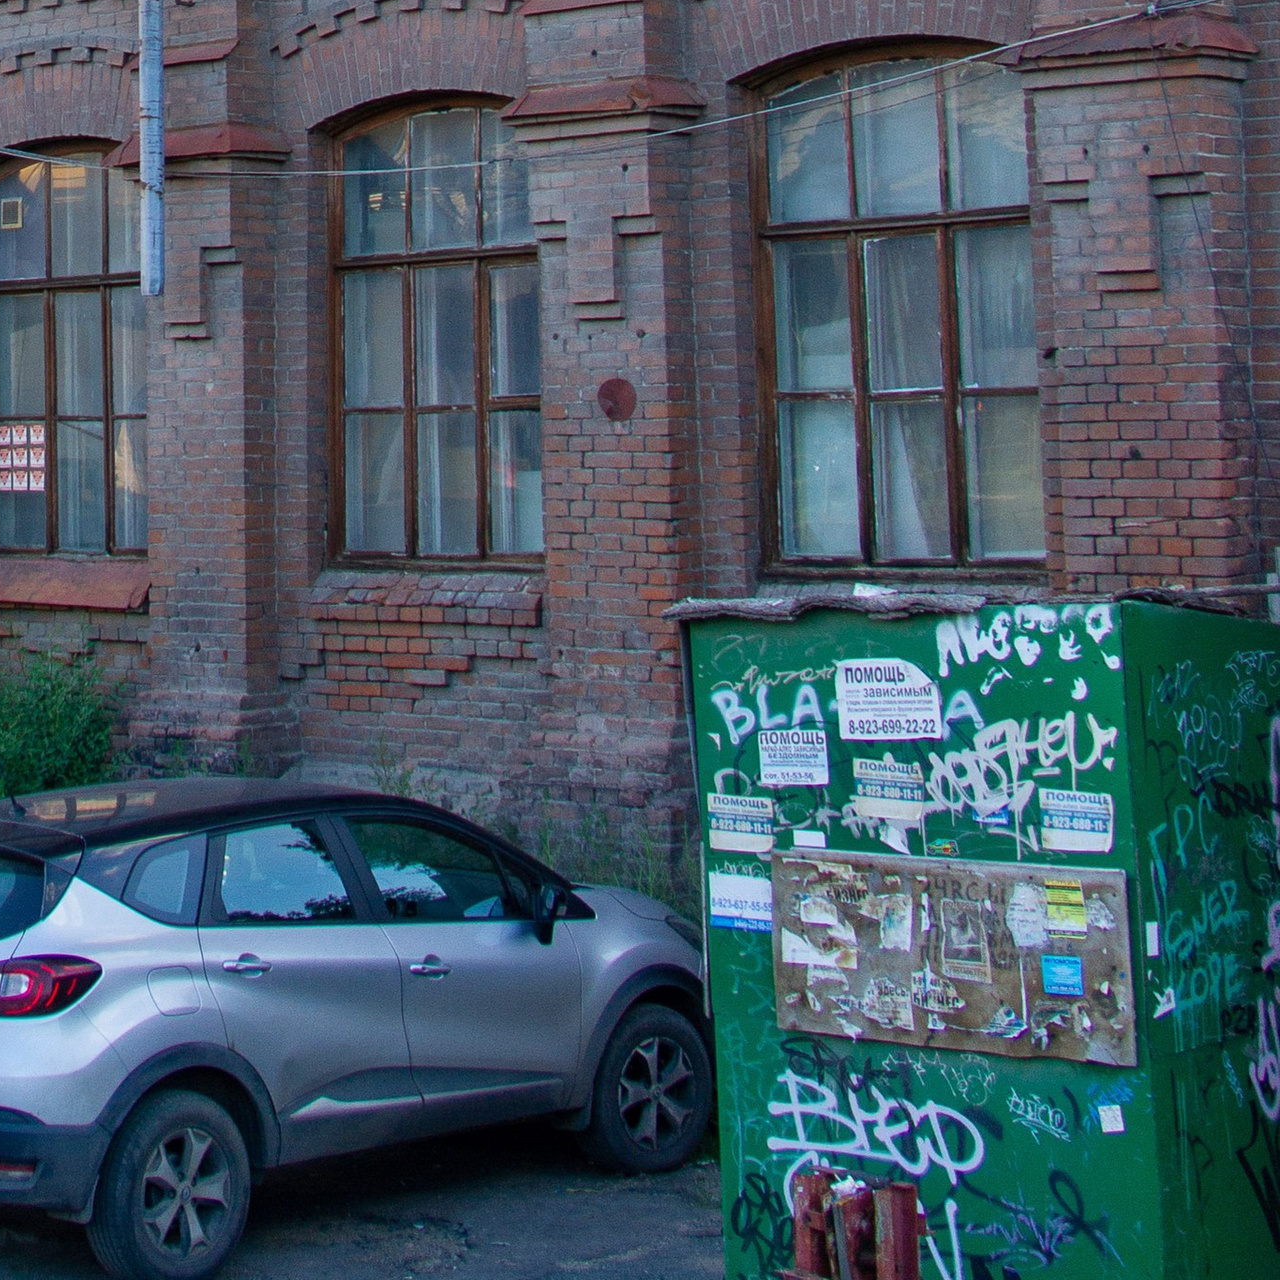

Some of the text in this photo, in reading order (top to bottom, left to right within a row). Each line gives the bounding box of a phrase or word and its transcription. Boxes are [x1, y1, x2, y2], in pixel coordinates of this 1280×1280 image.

[845, 665, 905, 685] ПОМОЩЬ
[863, 687, 932, 698] зависимым
[849, 719, 936, 735] 8-923-699-22-22
[760, 731, 825, 745] ПОМОЩЬ
[713, 796, 768, 809] ПОМОЩЬ
